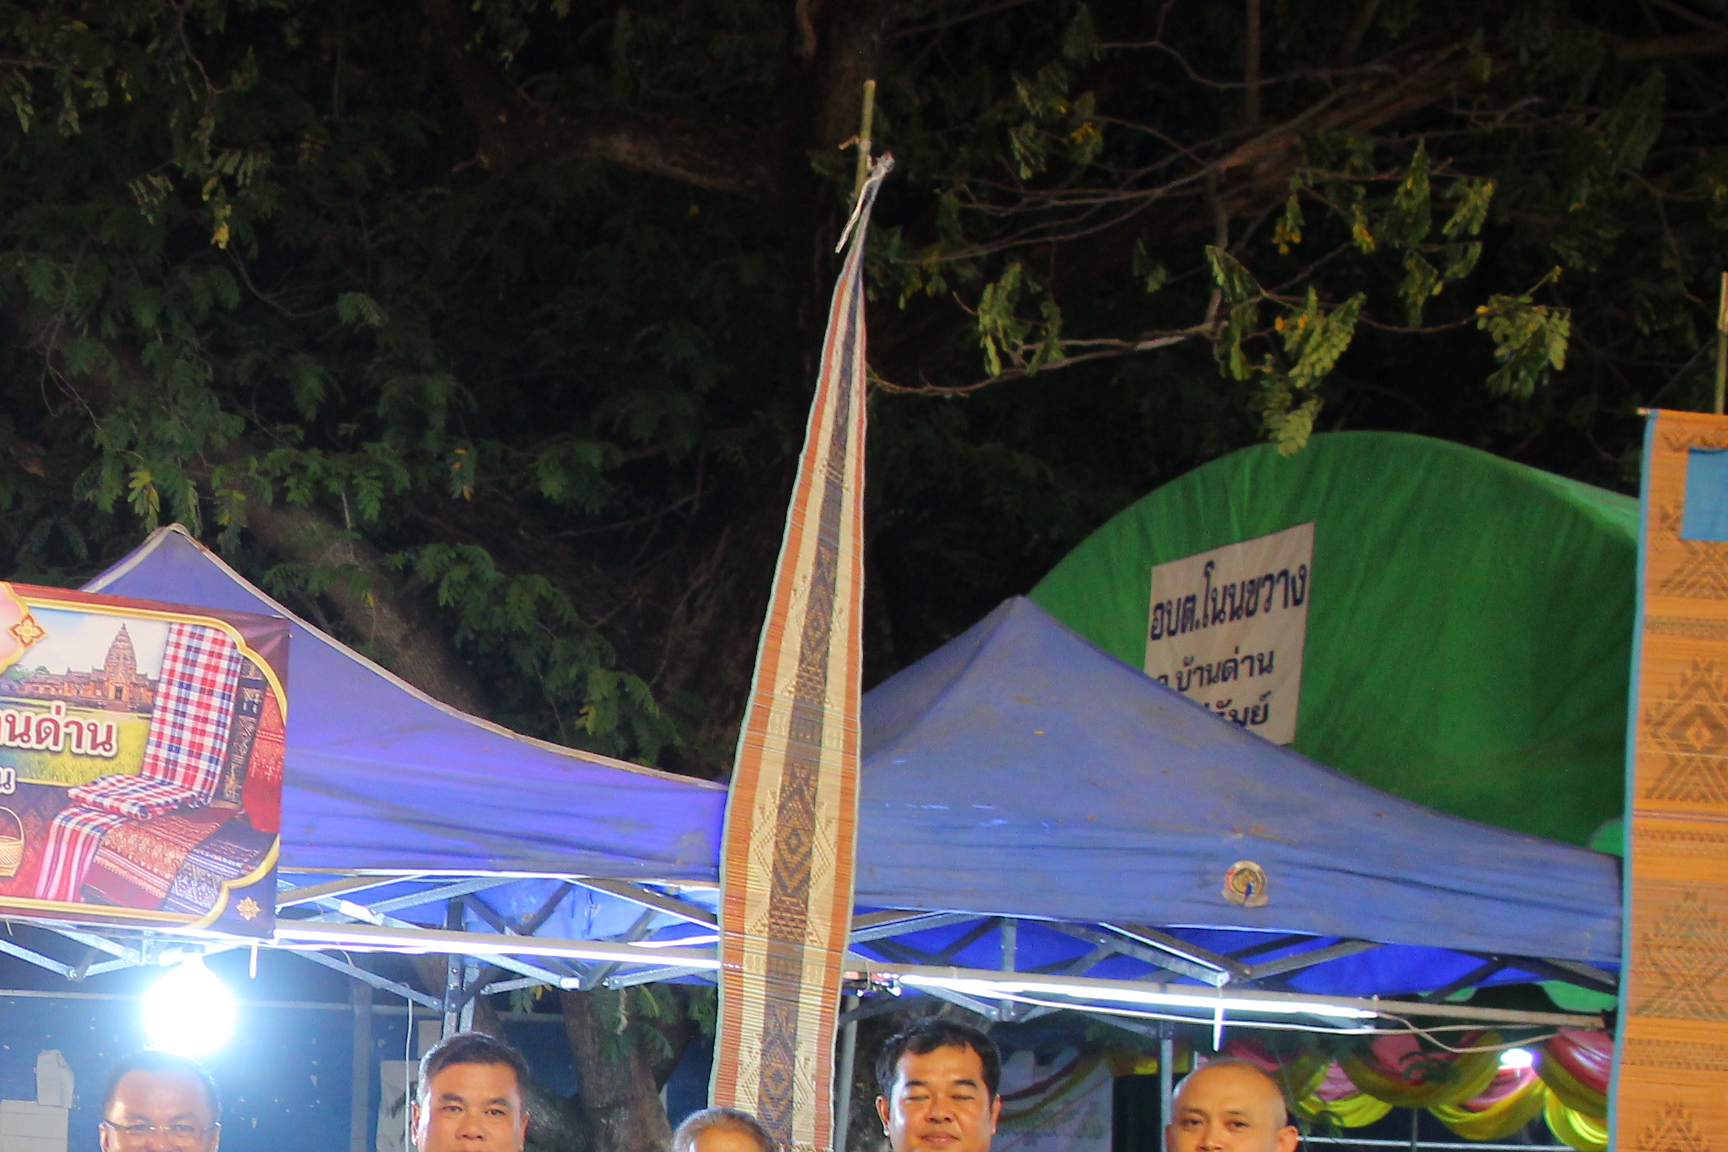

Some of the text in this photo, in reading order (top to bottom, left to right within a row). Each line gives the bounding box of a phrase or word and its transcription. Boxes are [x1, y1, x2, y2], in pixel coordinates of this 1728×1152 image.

[1150, 559, 1308, 641] อบต.โนนขวาง
[1157, 645, 1275, 692] บ้านด่าน
